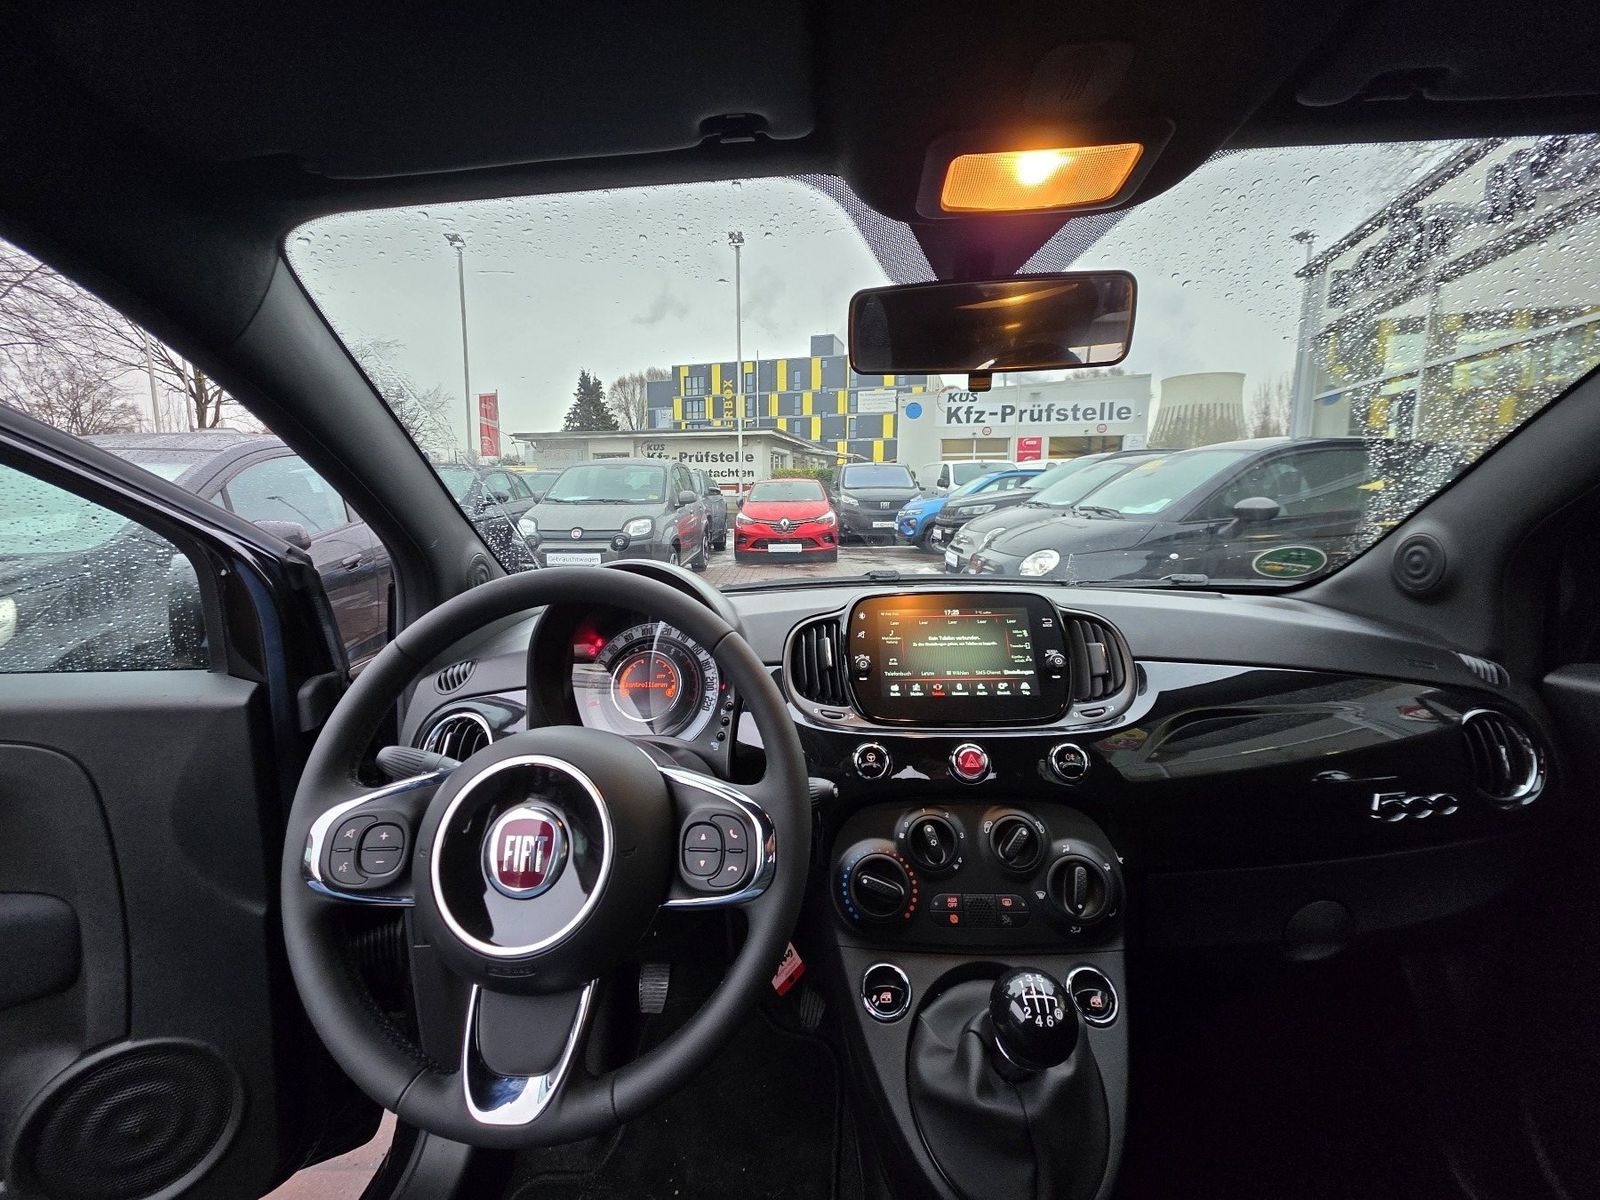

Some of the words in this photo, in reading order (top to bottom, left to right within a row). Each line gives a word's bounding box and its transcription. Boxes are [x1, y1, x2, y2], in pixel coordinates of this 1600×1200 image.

[947, 393, 978, 403] KÜS
[946, 402, 1132, 424] Kfz-Prüfstelle
[705, 676, 715, 692] 200
[702, 696, 713, 712] 220
[1370, 791, 1459, 823] 500
[502, 835, 549, 873] FIAT
[1025, 974, 1033, 982] 3
[1036, 974, 1044, 983] 5
[1023, 1006, 1032, 1019] 2
[1035, 1015, 1044, 1028] 4
[1046, 1015, 1055, 1028] 6
